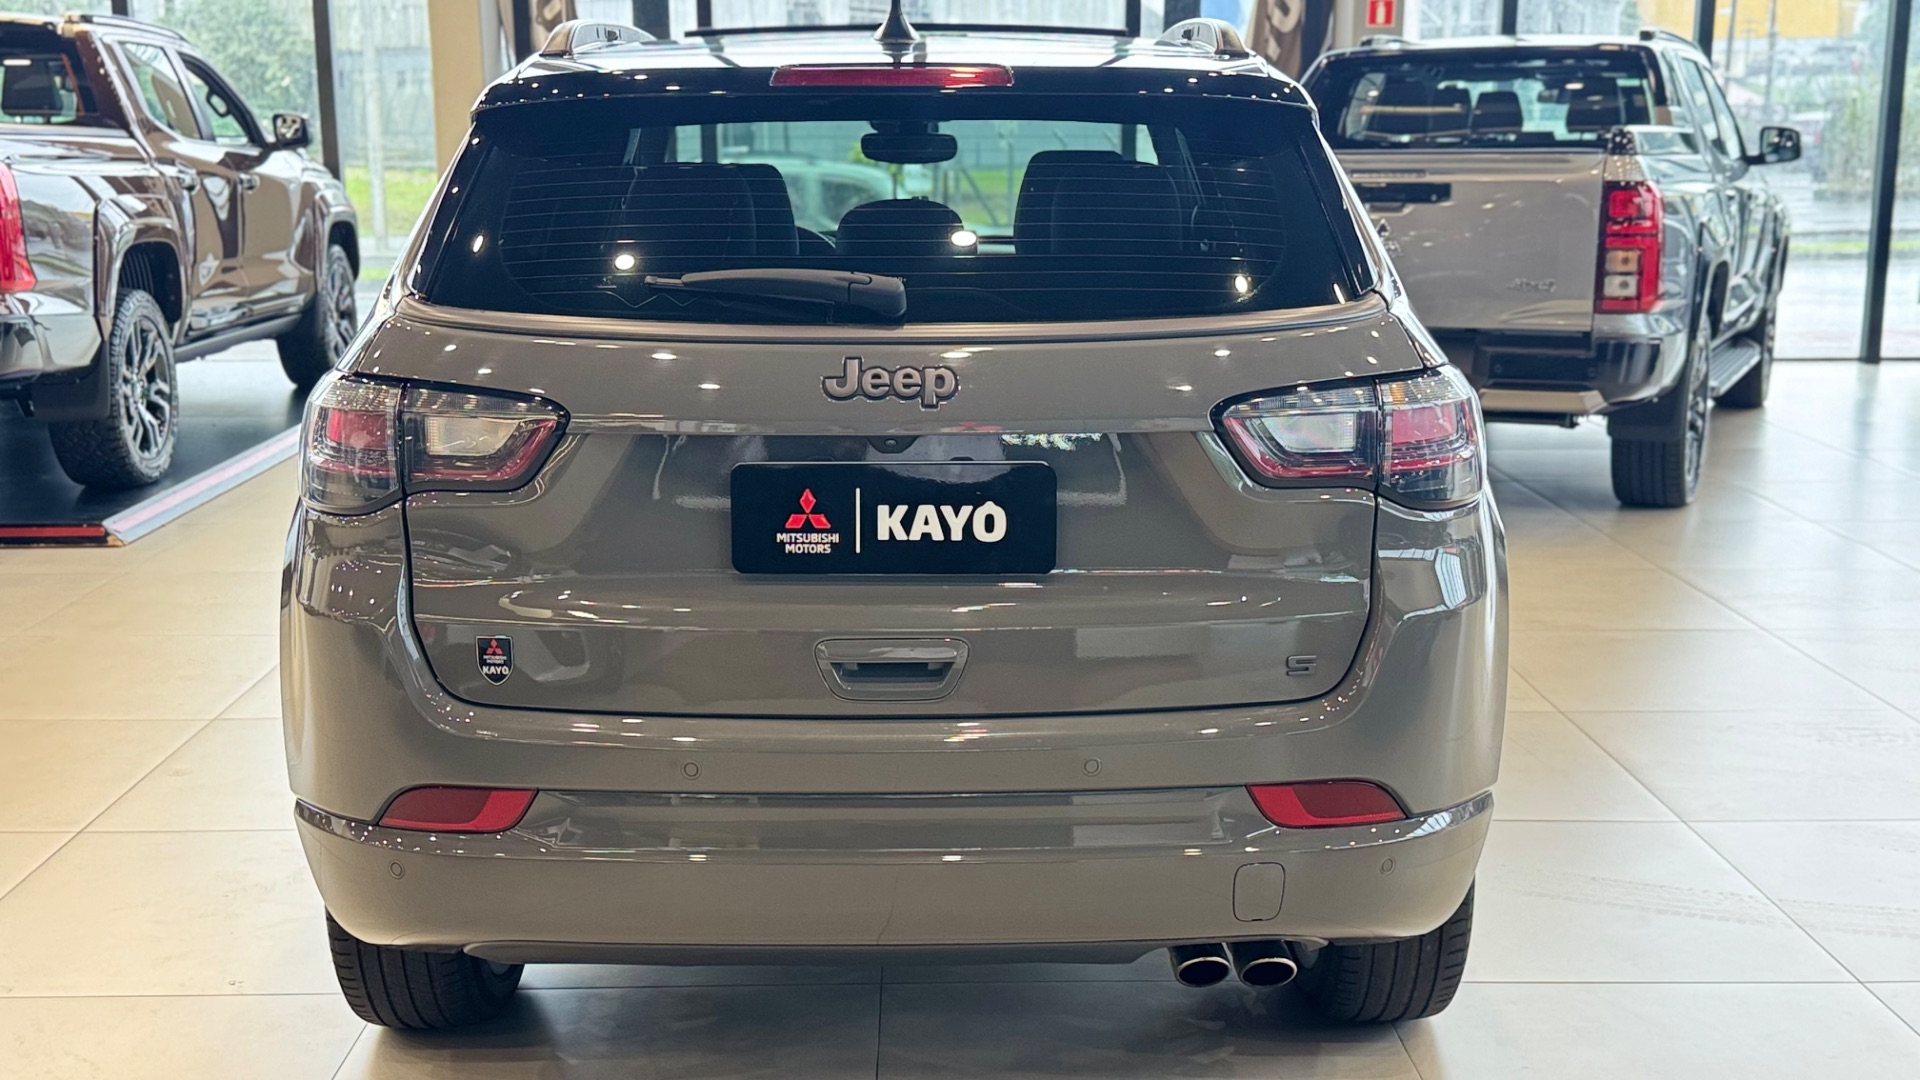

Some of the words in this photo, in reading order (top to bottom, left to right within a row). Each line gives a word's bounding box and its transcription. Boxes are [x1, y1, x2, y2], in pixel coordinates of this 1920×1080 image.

[822, 356, 958, 408] Jeep
[877, 501, 1007, 543] KAYÔ
[776, 532, 839, 543] MITSUBISHI
[785, 544, 831, 554] MOTORS
[1286, 655, 1317, 676] S
